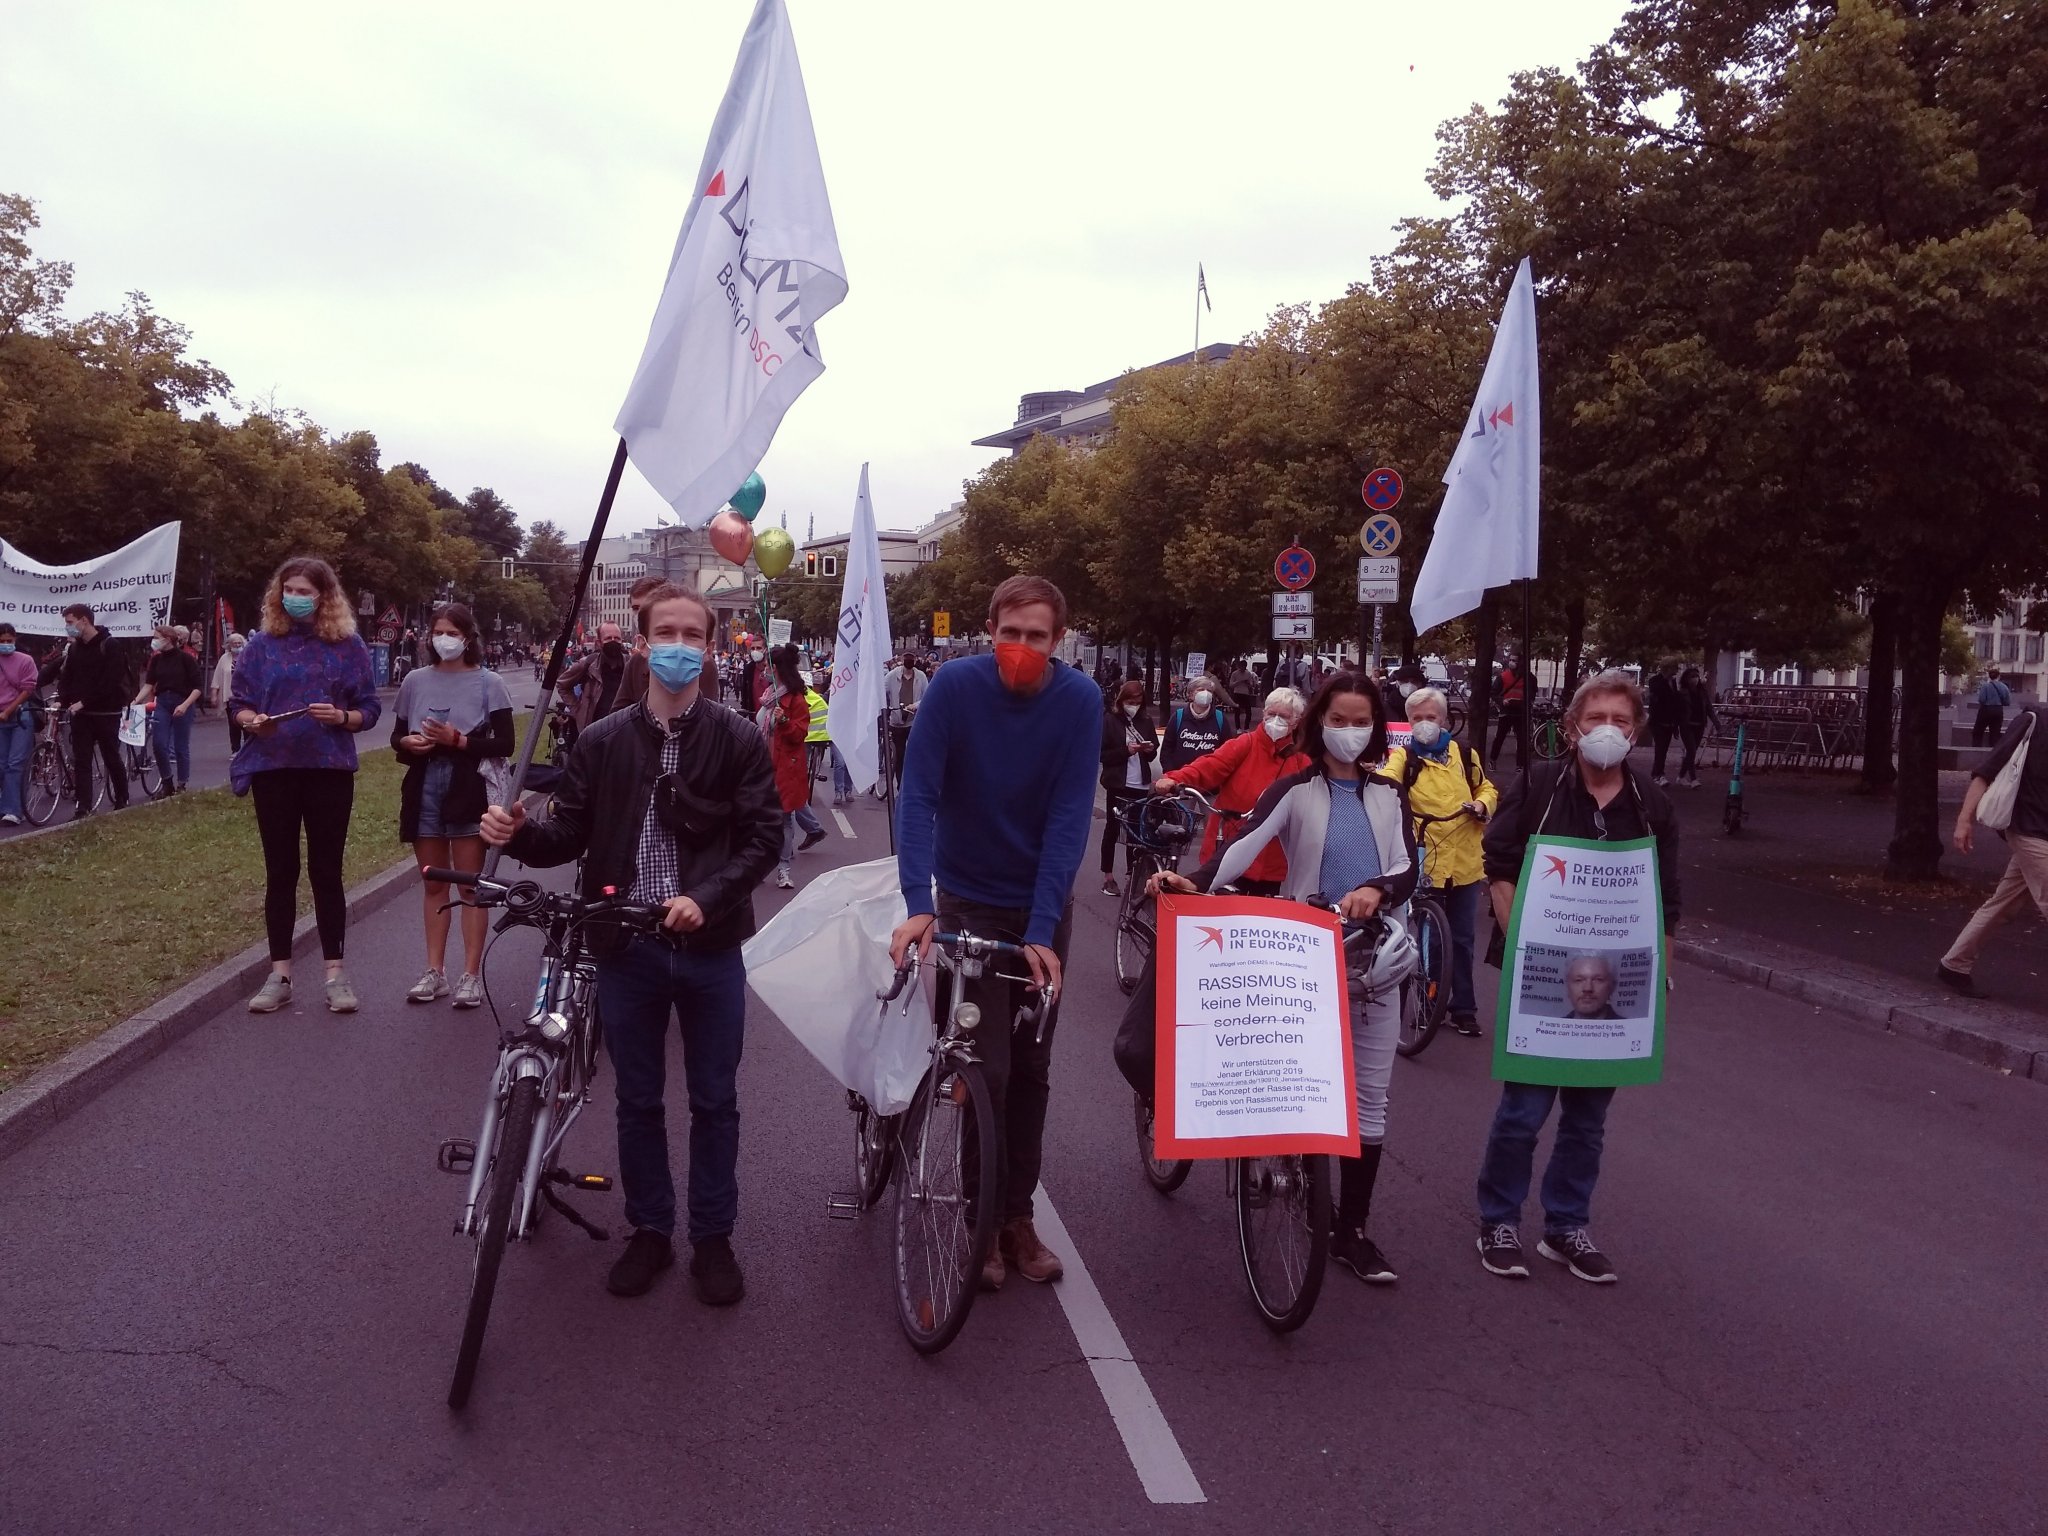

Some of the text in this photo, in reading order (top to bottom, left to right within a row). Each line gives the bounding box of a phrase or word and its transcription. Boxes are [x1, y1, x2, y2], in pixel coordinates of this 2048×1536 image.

[750, 326, 783, 376] DSC
[1363, 565, 1369, 574] 8
[22, 601, 141, 615] Unterckung.
[382, 629, 394, 639] 30
[1573, 863, 1646, 876] DEMOKRATIE
[1572, 874, 1639, 888] IN EUROPA
[1543, 908, 1640, 924] Sofortige Freiheit für
[1230, 928, 1320, 946] DEMOKRATIE
[1555, 924, 1629, 939] Julian Assange
[1230, 940, 1306, 954] IN EUROPA
[1525, 945, 1568, 959] THIS MAN
[1621, 953, 1637, 961] AND
[1523, 964, 1559, 974] NELSON
[1198, 974, 1319, 993] RASSISMUS ist
[1522, 974, 1565, 985] MANDELA
[1618, 990, 1638, 998] YOUR
[1201, 993, 1317, 1012] keine Meinung,
[1213, 1013, 1305, 1027] sondern ein
[1215, 1030, 1304, 1047] Verbrechen
[1535, 1028, 1557, 1036] Peace
[1221, 1057, 1299, 1069] Wir unterstützen die
[1216, 1067, 1304, 1079] Jenaer Erklärung 2019
[1201, 1084, 1321, 1097] Das Konzept der Rasse ist das
[1195, 1098, 1229, 1108] Ergebnis
[1245, 1095, 1289, 1104] Rassismus
[1289, 1094, 1307, 1102] und
[1307, 1095, 1328, 1103] nicht
[1215, 1107, 1244, 1116] dessen
